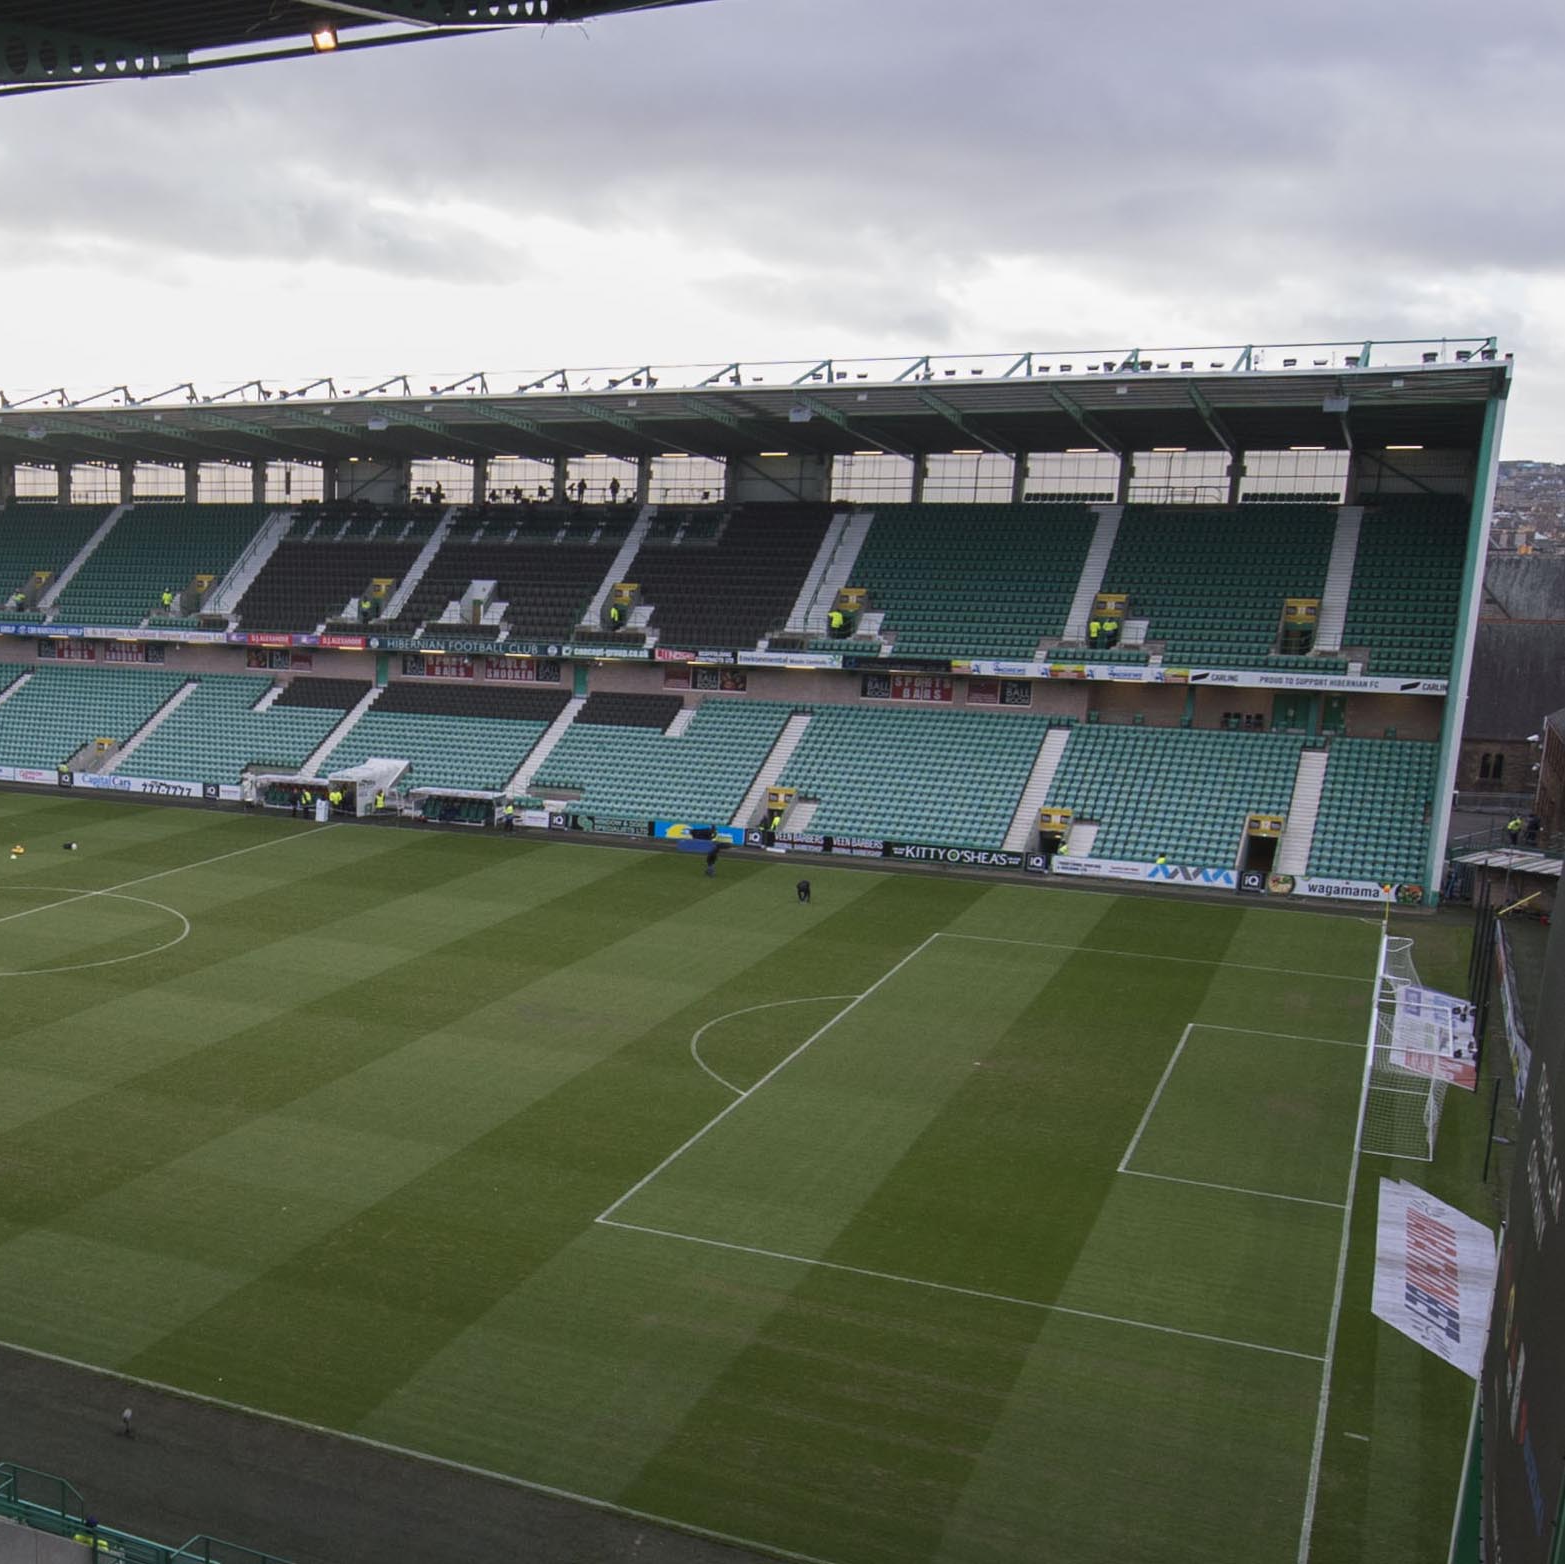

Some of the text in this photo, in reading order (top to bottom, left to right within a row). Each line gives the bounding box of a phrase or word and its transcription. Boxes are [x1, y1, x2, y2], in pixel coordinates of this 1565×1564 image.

[387, 639, 538, 654] HIBERNIAN FOOTBALL CLUB
[1211, 674, 1448, 692] CARLING PROUD TO SUPPORT HIBERNIAN FC CARLIN
[902, 688, 942, 699] BARS
[1005, 688, 1030, 697] BALL
[81, 773, 110, 789] Capital
[112, 775, 132, 790] Cars
[906, 845, 945, 860] KITTY
[947, 849, 1008, 866] O'SHEA'S
[1308, 883, 1380, 898] wagamama
[1404, 1207, 1460, 1344] MARATHONBET
